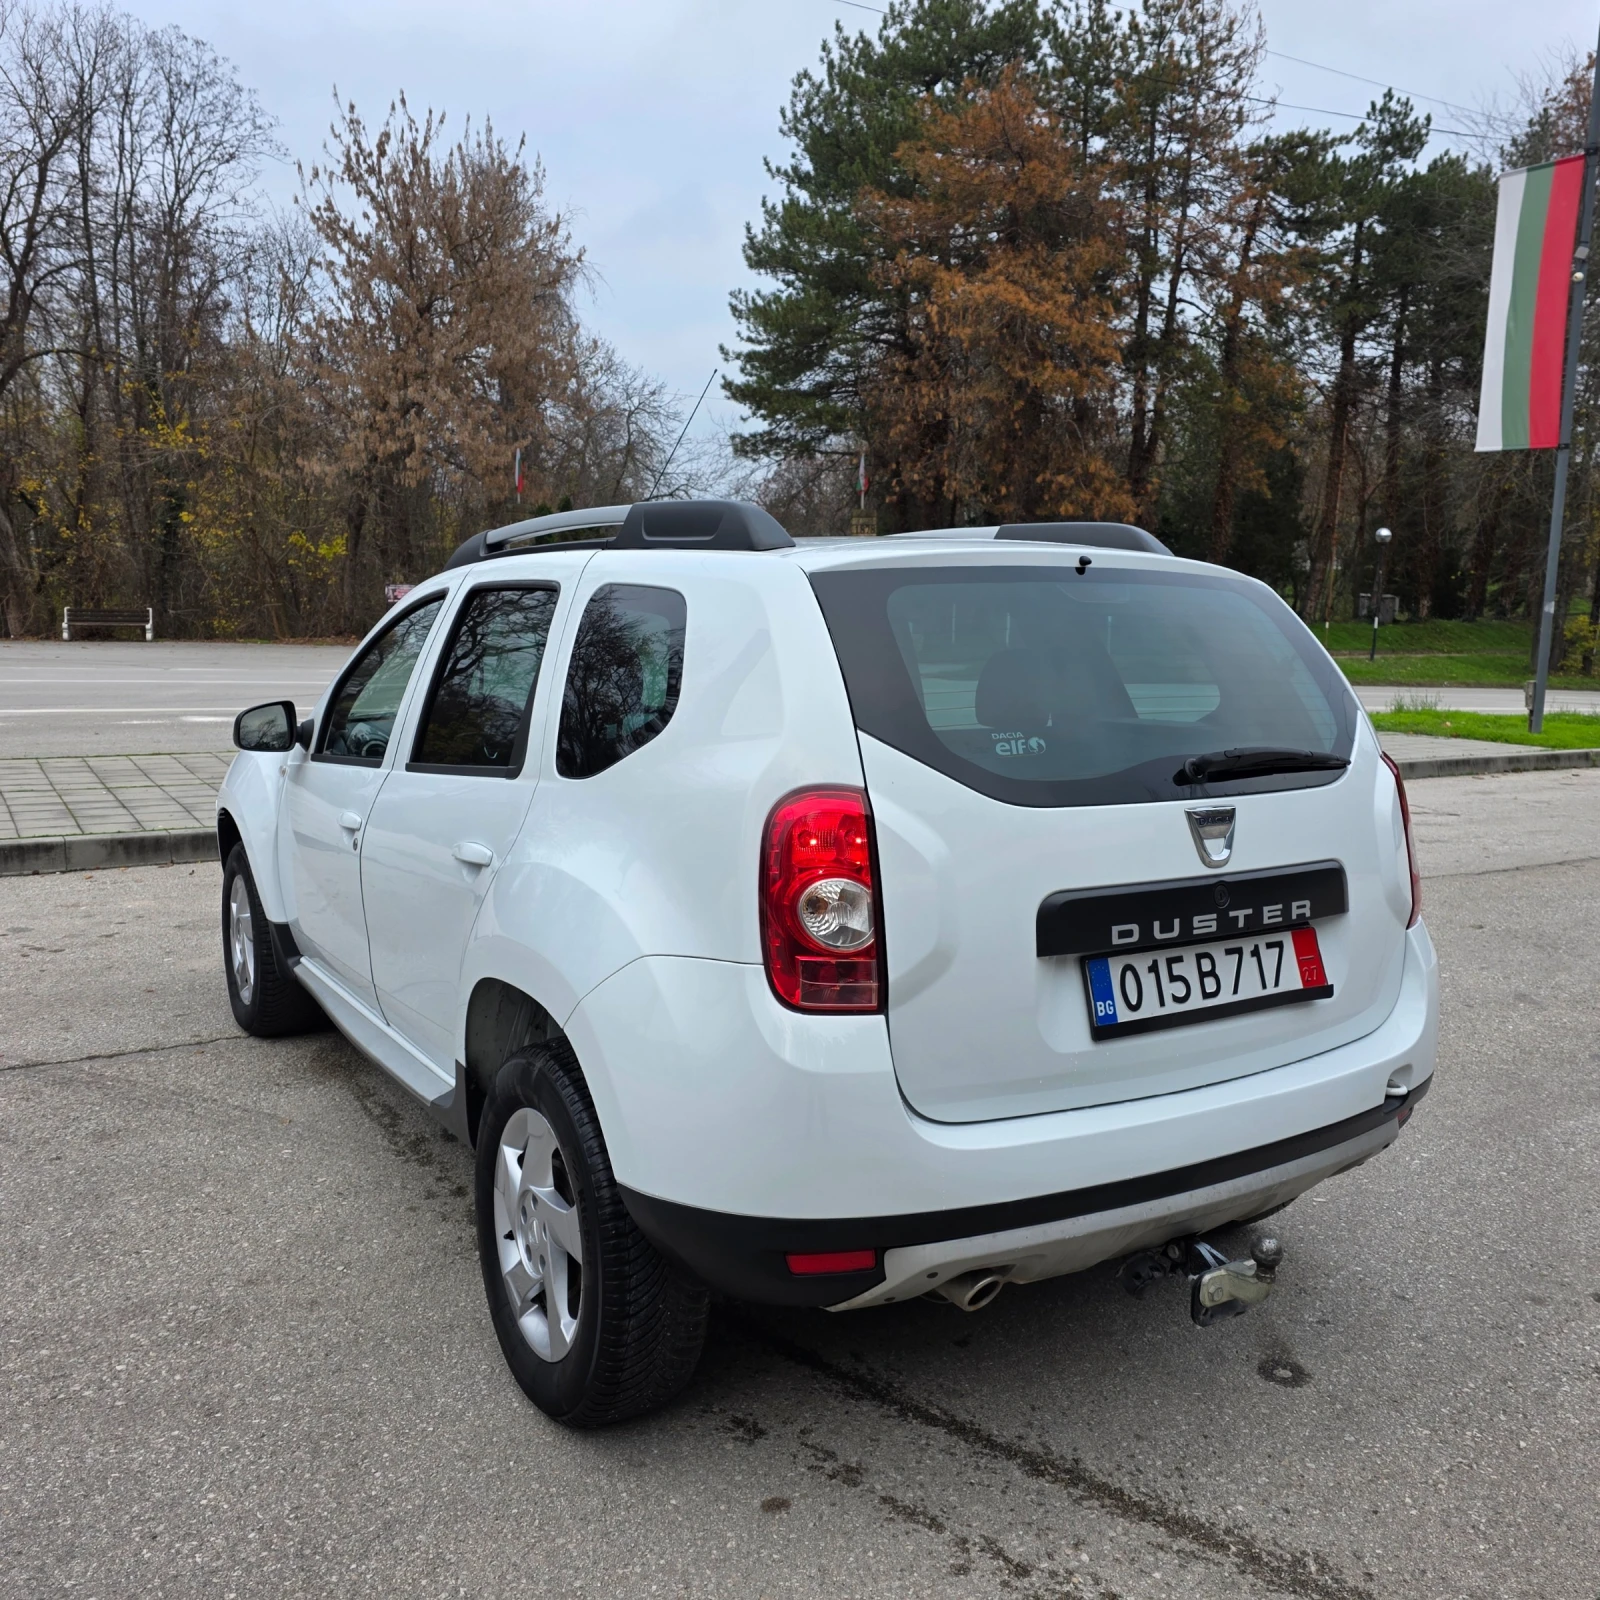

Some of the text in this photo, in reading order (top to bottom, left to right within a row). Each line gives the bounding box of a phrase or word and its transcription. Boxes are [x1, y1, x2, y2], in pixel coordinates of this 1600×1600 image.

[991, 731, 1024, 740] DACIA
[995, 739, 1026, 756] elf
[1111, 900, 1311, 945] DUSTER
[1119, 940, 1284, 1012] 015B717
[1302, 965, 1317, 981] 27
[1096, 1001, 1114, 1017] BG
